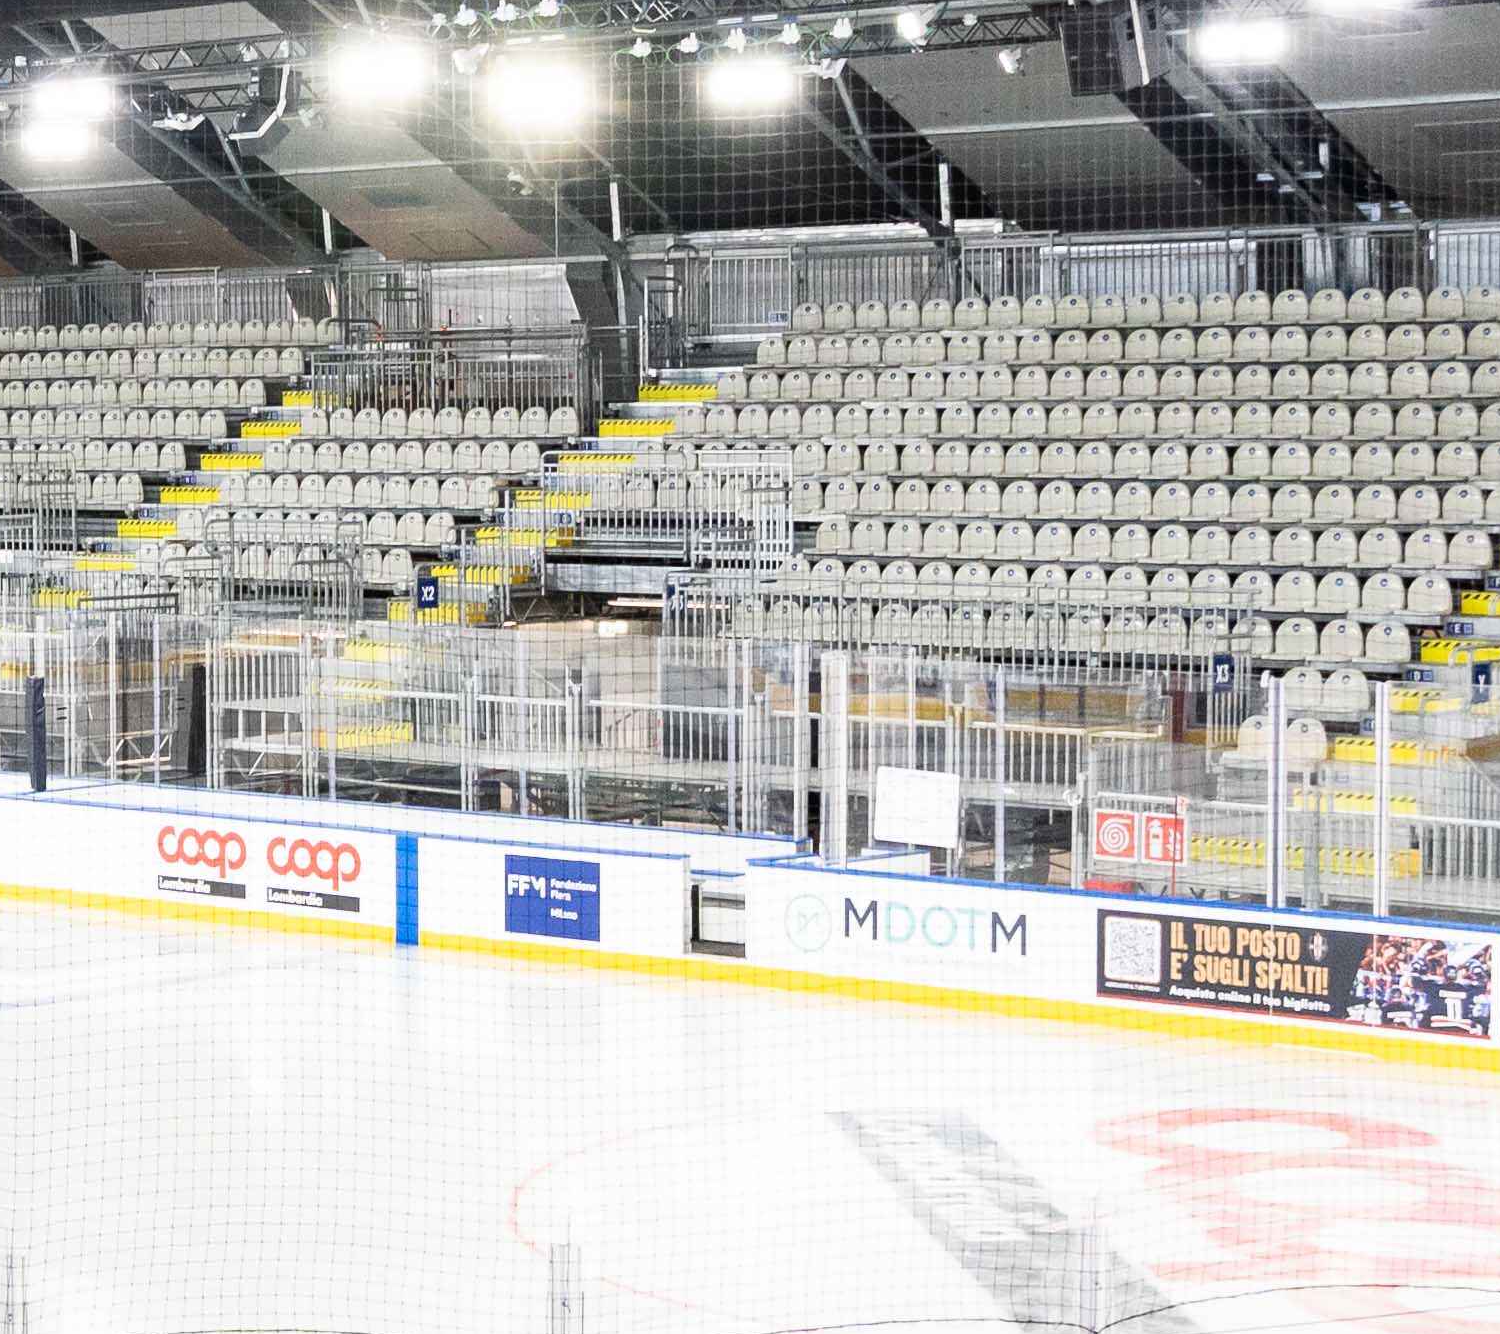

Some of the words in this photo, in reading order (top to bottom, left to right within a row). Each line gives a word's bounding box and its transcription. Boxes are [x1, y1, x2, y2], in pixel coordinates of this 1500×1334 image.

[421, 586, 435, 601] X2
[158, 826, 246, 878] coop
[267, 836, 361, 891] coop
[844, 897, 1026, 956] MDOTM
[1170, 921, 1188, 951] IL
[1194, 923, 1231, 954] TUO
[1237, 926, 1300, 962] POSTO
[1170, 951, 1190, 981] E'
[1194, 954, 1251, 987] SUGLI
[1255, 959, 1329, 996] SPALTI!
